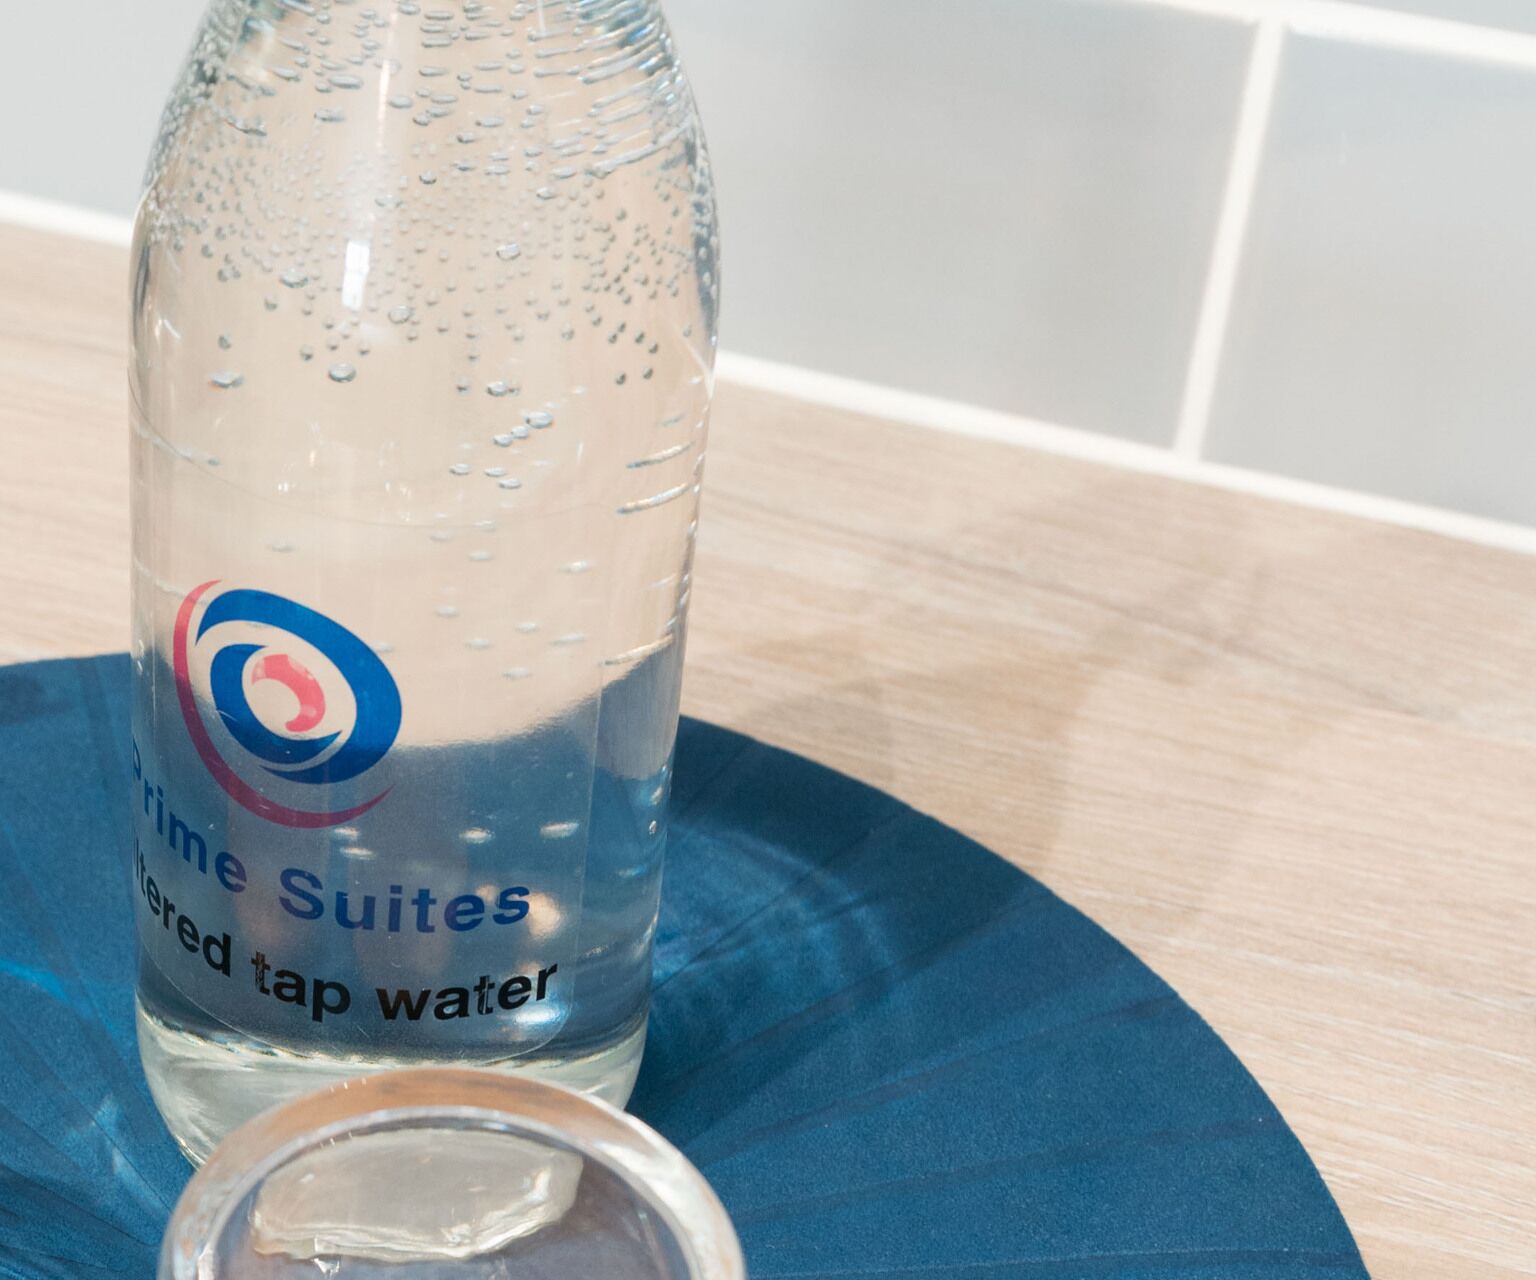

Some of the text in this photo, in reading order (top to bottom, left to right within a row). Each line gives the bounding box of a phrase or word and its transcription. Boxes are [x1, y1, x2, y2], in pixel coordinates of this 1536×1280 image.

[278, 868, 531, 934] Suites
[251, 951, 351, 1023] tap
[376, 963, 559, 1021] water
